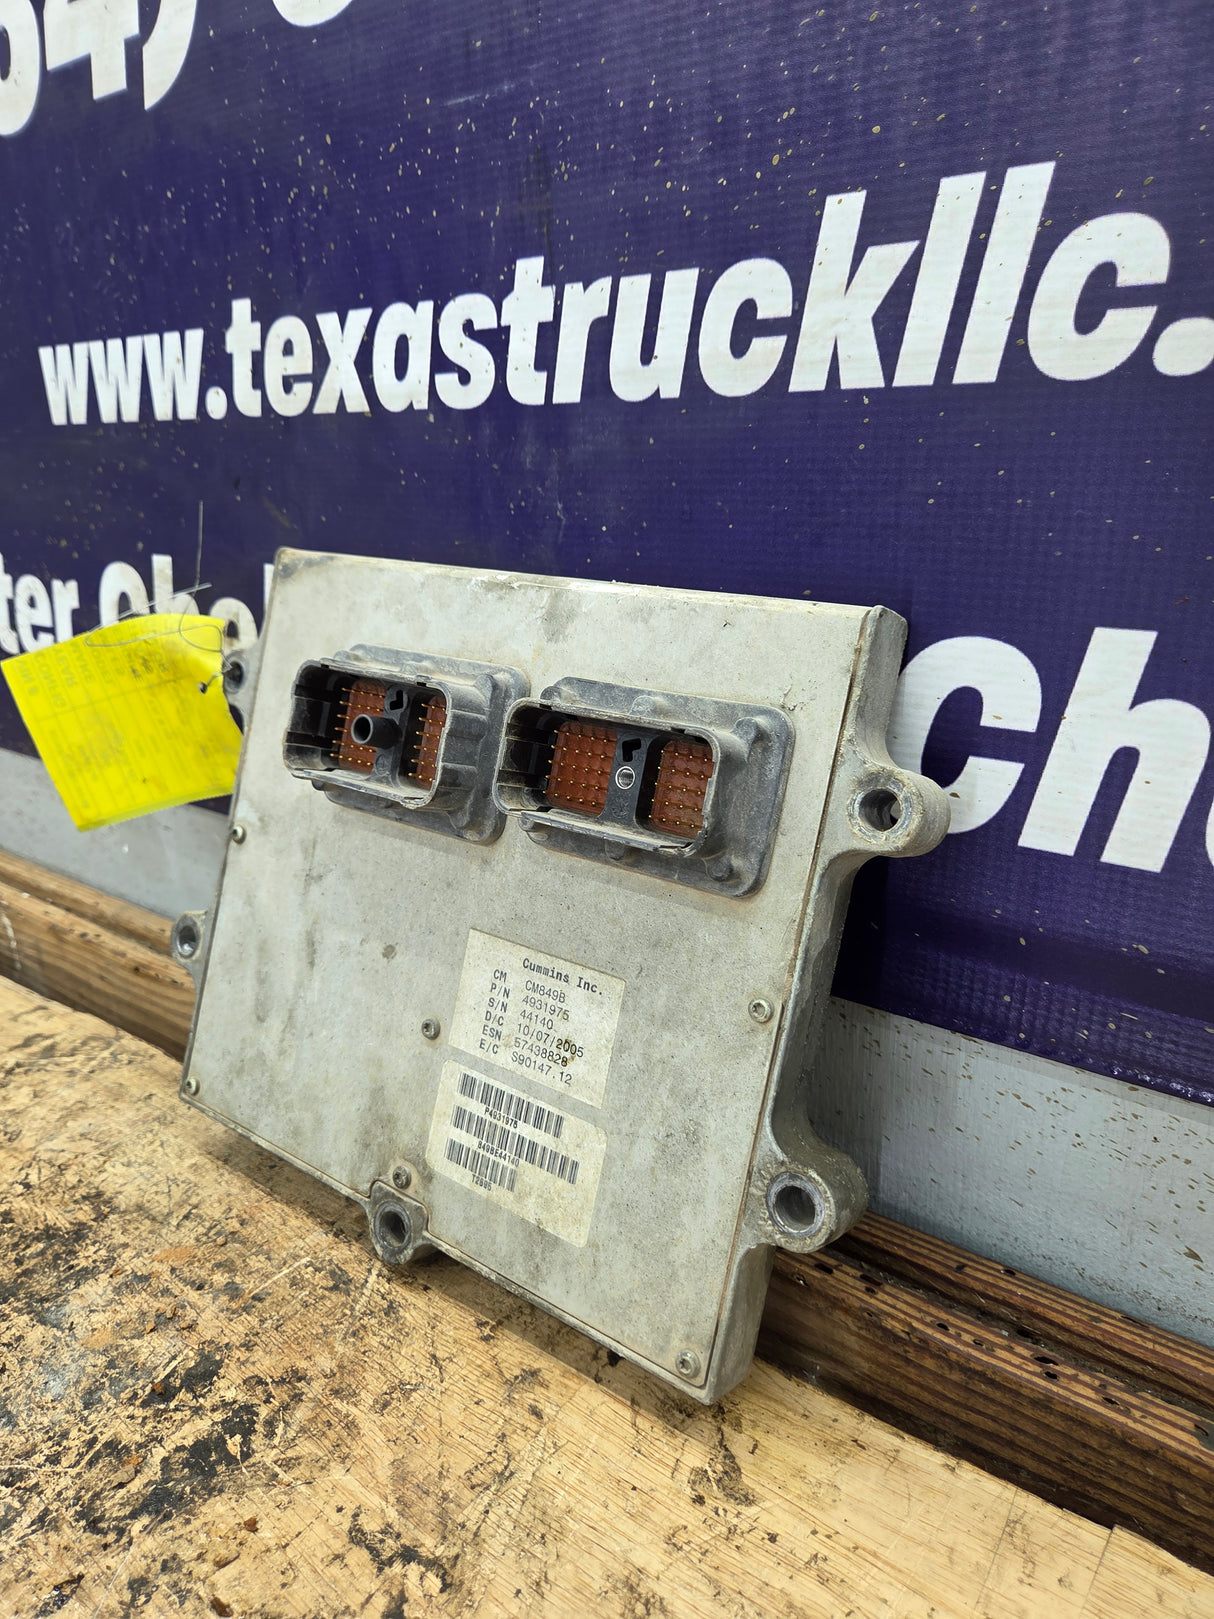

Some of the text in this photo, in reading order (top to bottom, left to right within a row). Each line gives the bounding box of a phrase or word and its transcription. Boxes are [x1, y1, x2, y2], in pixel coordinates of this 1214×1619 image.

[885, 626, 1214, 873] Ch
[493, 968, 566, 1004] CM CM849B
[522, 957, 603, 996] Cummins Inc.
[487, 997, 554, 1030] S/N 44140
[489, 982, 570, 1021] P/N 4931975
[481, 1024, 568, 1068] ESN 57438828
[484, 1010, 584, 1058] D/C 10/07/2005
[479, 1038, 573, 1085] E/C S90147.12
[484, 1106, 518, 1129] P4931975
